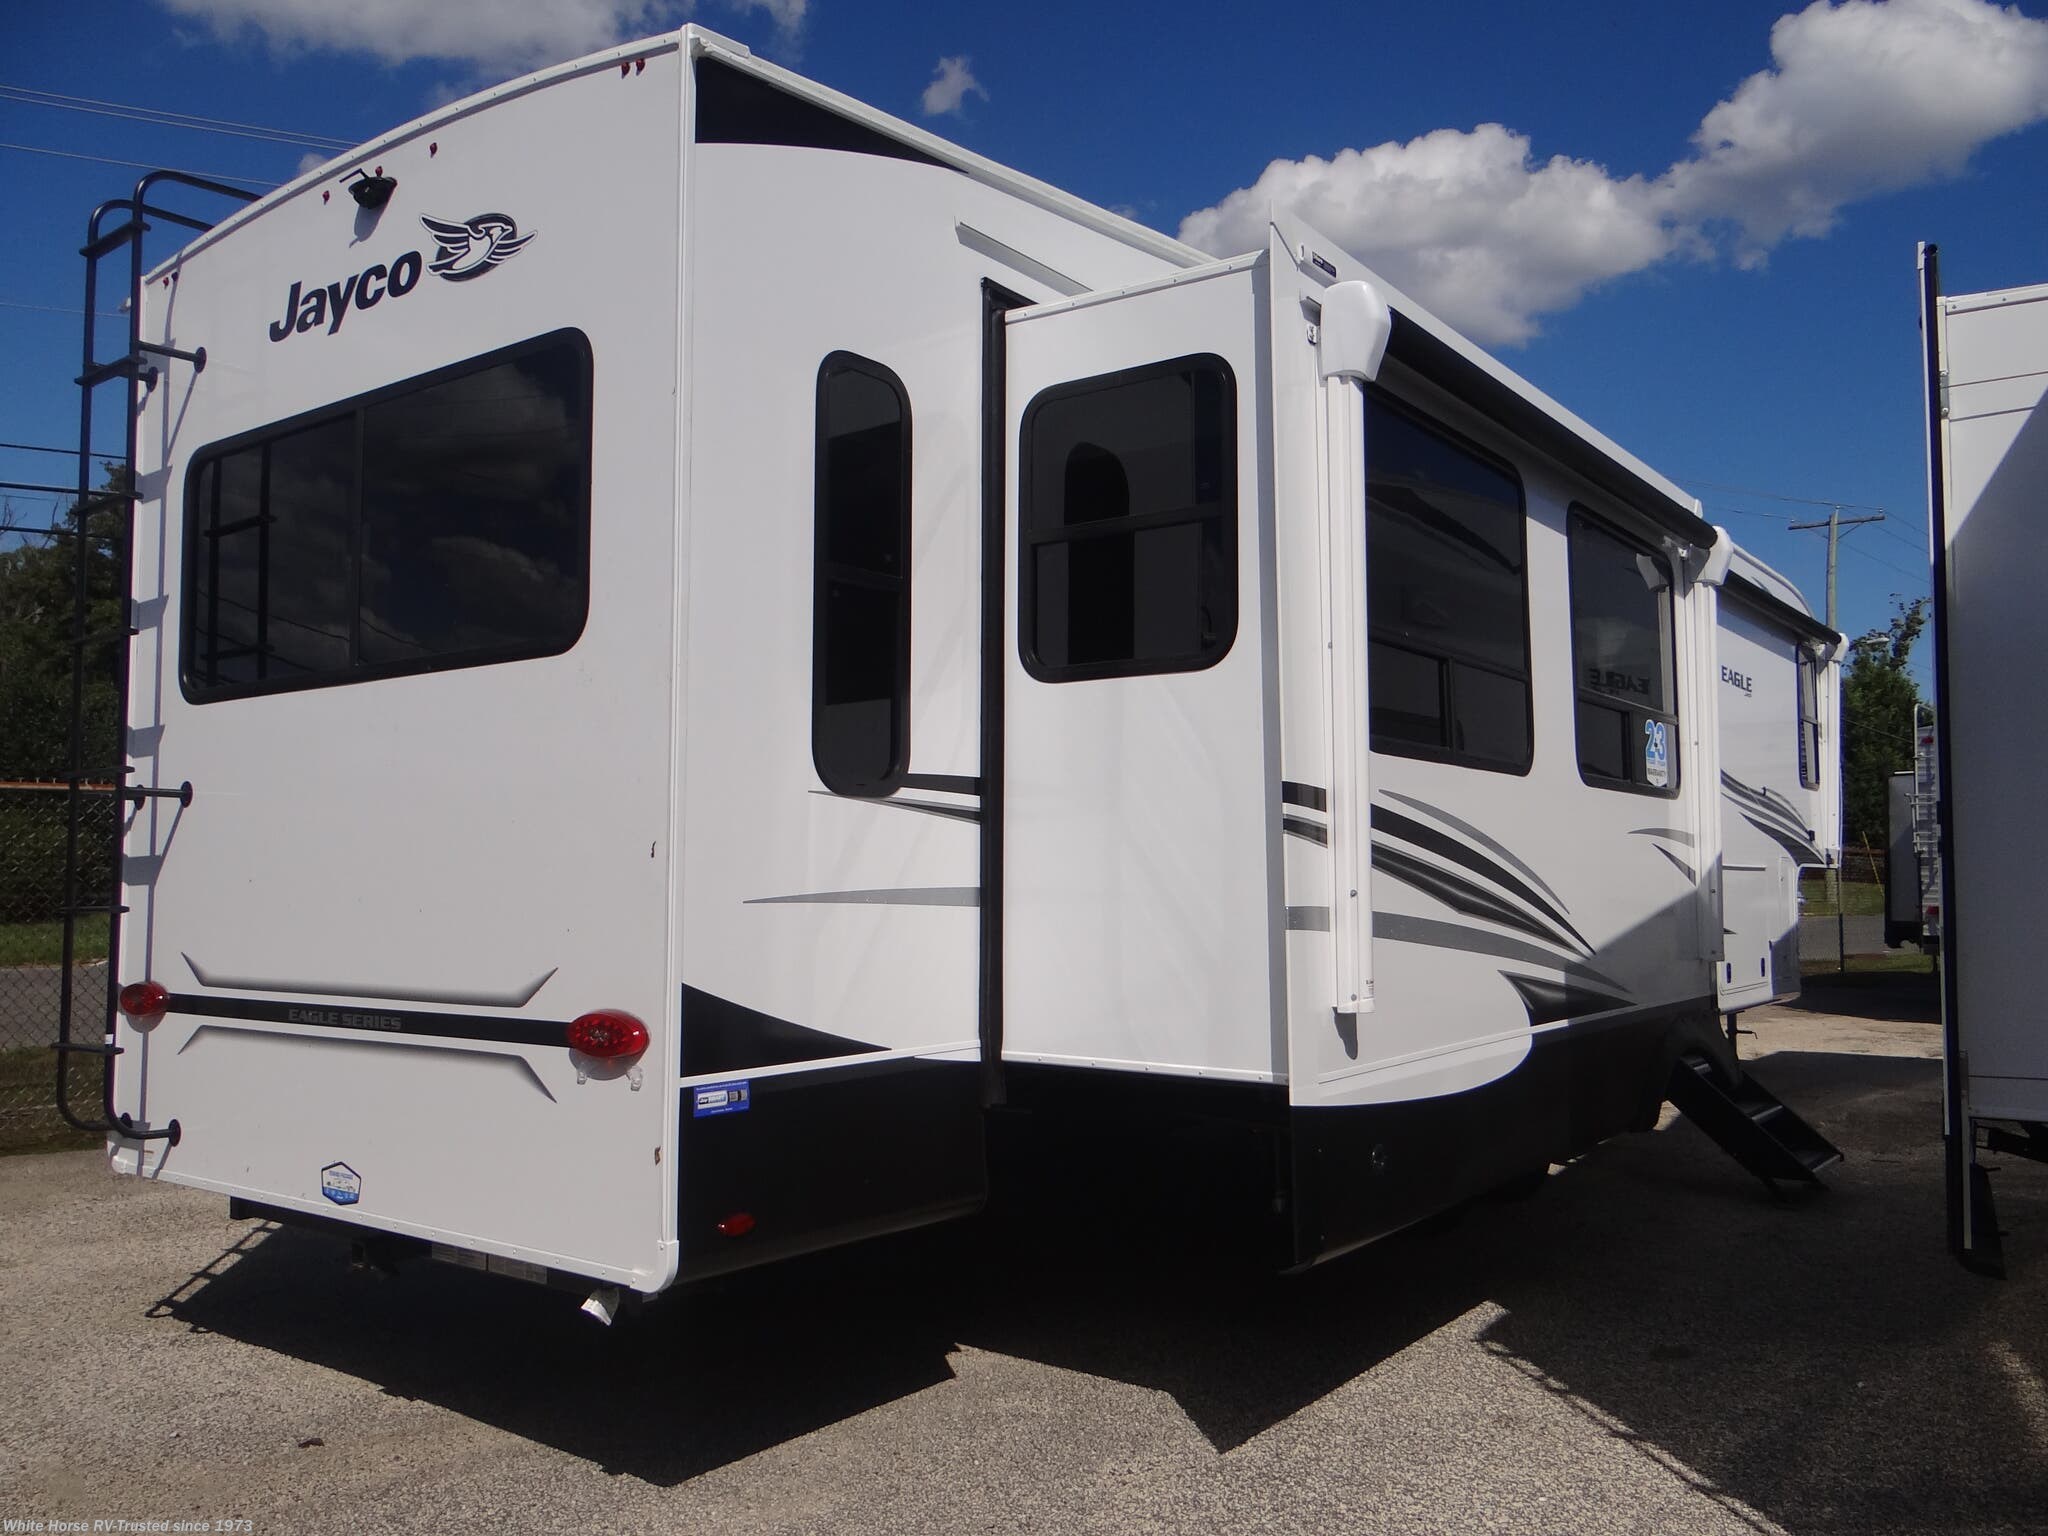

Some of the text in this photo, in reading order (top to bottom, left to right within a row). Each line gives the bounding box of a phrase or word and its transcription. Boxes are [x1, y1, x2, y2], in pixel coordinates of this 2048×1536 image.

[269, 250, 422, 342] Jayco
[1721, 665, 1752, 693] EAGLE
[289, 1009, 401, 1030] EAGLE SERIES
